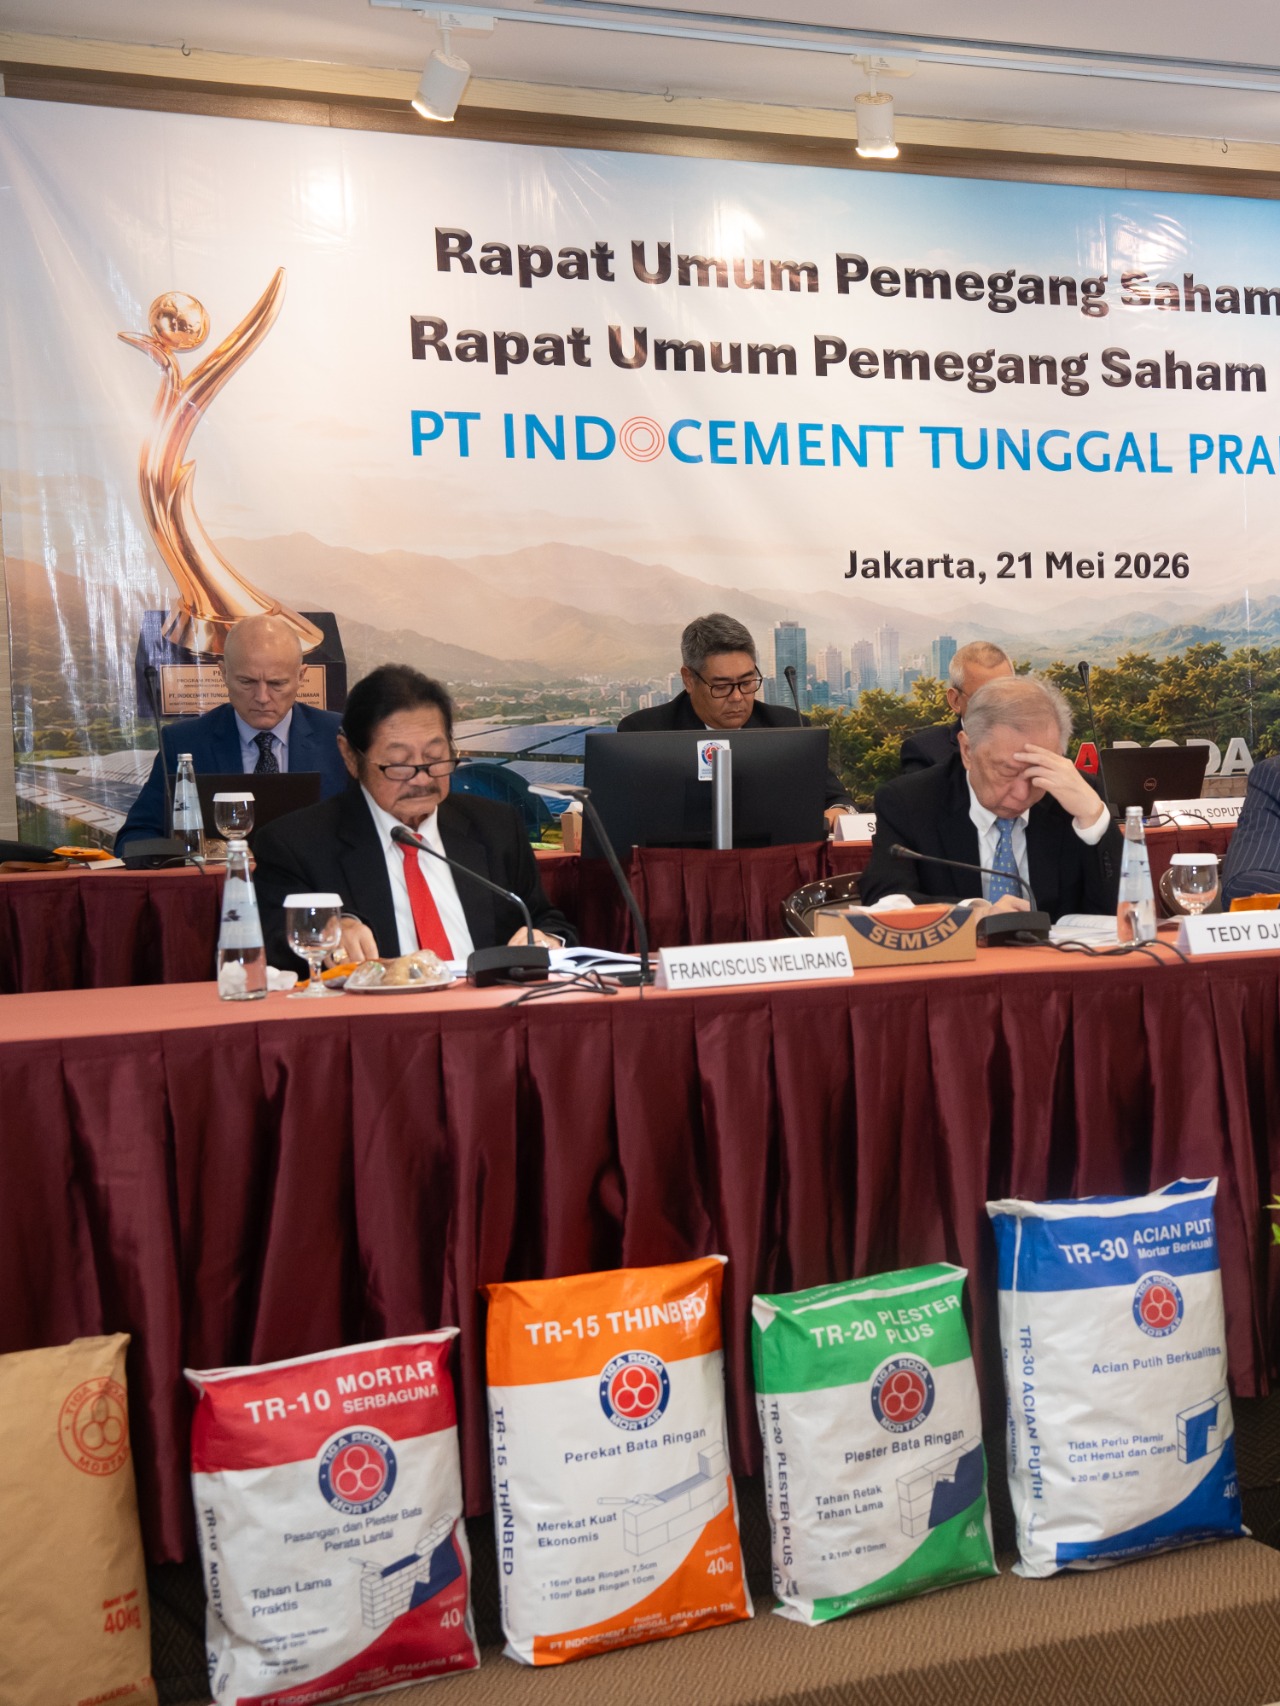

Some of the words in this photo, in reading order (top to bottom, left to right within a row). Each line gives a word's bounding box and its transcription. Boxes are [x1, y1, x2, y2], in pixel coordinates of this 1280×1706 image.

[434, 226, 615, 288] Rapat
[630, 239, 819, 293] Umum
[836, 252, 1109, 318] Pemegang
[409, 314, 591, 375] Rapat
[607, 324, 798, 376] Umum
[813, 334, 1090, 397] Pemegang
[1101, 346, 1268, 393] Saham
[410, 409, 481, 457] PT
[504, 413, 904, 468] INDOCEMENT
[920, 426, 1173, 473] TUNGGAL
[844, 549, 987, 585] Jakarta,
[996, 551, 1033, 579] 21
[1045, 550, 1105, 580] Mei
[1114, 551, 1190, 580] 2026
[1206, 806, 1244, 818] SOPUT
[868, 917, 959, 951] SEMEN
[1207, 926, 1255, 944] TEDY
[670, 957, 767, 981] FRANCISCUS
[770, 951, 848, 973] WELIRANG
[1057, 1236, 1129, 1264] TR-30
[1133, 1223, 1181, 1246] ACIAN
[1184, 1218, 1213, 1237] PUT
[1137, 1245, 1170, 1259] Mortar
[524, 1315, 600, 1346] TR-15
[605, 1297, 706, 1334] THINBED
[809, 1319, 877, 1348] TR-20
[877, 1294, 960, 1325] PLESTER
[886, 1323, 934, 1344] PLUS
[1019, 1324, 1034, 1377] TR-30
[1091, 1361, 1130, 1375] Acian
[1132, 1356, 1163, 1370] Putih
[1166, 1346, 1221, 1365] Berkualitas
[601, 1358, 625, 1381] TIGA
[628, 1354, 663, 1374] RODA
[874, 1364, 896, 1387] TIGA
[899, 1360, 928, 1379] RODA
[244, 1389, 331, 1424] TR-10
[336, 1360, 435, 1395] MORTAR
[342, 1384, 439, 1414] SERBAGUNA
[610, 1409, 662, 1430] MORTAR
[770, 1401, 783, 1444] TR-20
[880, 1413, 926, 1432] MORTAR
[1022, 1381, 1038, 1439] ACIAN
[321, 1438, 348, 1465] TIGA
[351, 1433, 388, 1454] RODA
[495, 1406, 507, 1466] TR-15
[564, 1445, 622, 1463] Perekat
[626, 1439, 658, 1453] Bata
[662, 1428, 706, 1446] Ringan
[844, 1446, 888, 1464] Plester
[892, 1438, 920, 1453] Bata
[924, 1429, 964, 1446] Ringan
[1068, 1438, 1098, 1450] Tidak
[1101, 1436, 1129, 1448] Perlu
[1069, 1452, 1088, 1463] Cat
[1090, 1449, 1125, 1461] Hemat
[1128, 1448, 1147, 1458] dan
[1150, 1444, 1177, 1456] Cerah
[777, 1452, 790, 1521] PLESTER
[1027, 1445, 1043, 1500] PUTIH
[331, 1491, 388, 1514] MORTAR
[815, 1492, 850, 1506] Tahan
[853, 1485, 883, 1499] Retak
[816, 1506, 852, 1520] Tahan
[855, 1500, 884, 1514] Lama
[284, 1528, 340, 1544] Pasangan
[342, 1521, 362, 1533] dan
[365, 1513, 399, 1526] Plester
[498, 1479, 515, 1576] THINBED
[536, 1518, 586, 1532] Merekat
[589, 1512, 617, 1525] Kuat
[324, 1539, 361, 1552] Perata
[363, 1529, 394, 1544] Lantai
[537, 1531, 599, 1547] Ekonomis
[782, 1526, 793, 1567] PLUS
[251, 1584, 291, 1599] Tahan
[296, 1578, 332, 1592] Lama
[252, 1600, 299, 1618] Praktis
